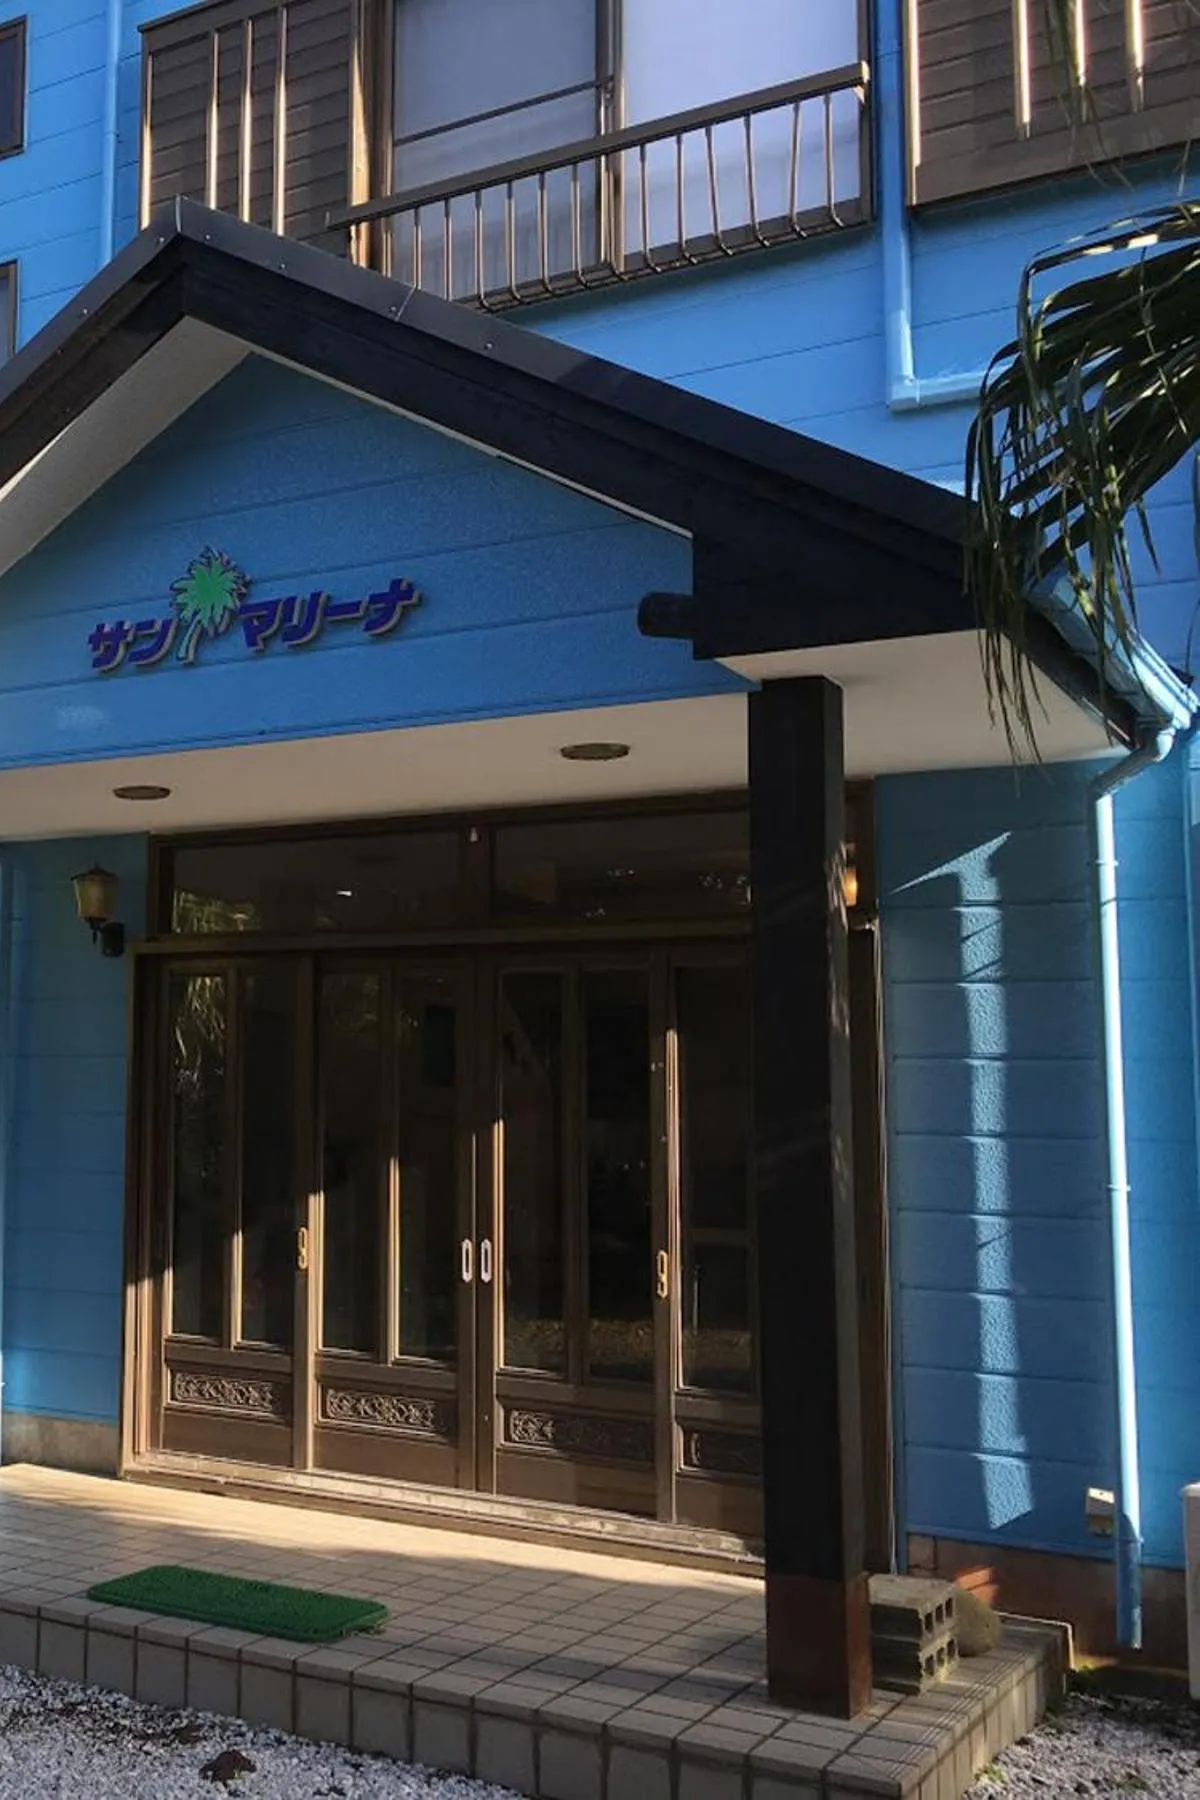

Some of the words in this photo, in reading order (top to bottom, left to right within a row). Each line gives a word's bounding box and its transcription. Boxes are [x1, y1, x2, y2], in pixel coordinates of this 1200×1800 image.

[88, 618, 178, 672] サン
[238, 577, 422, 651] マリーナ
